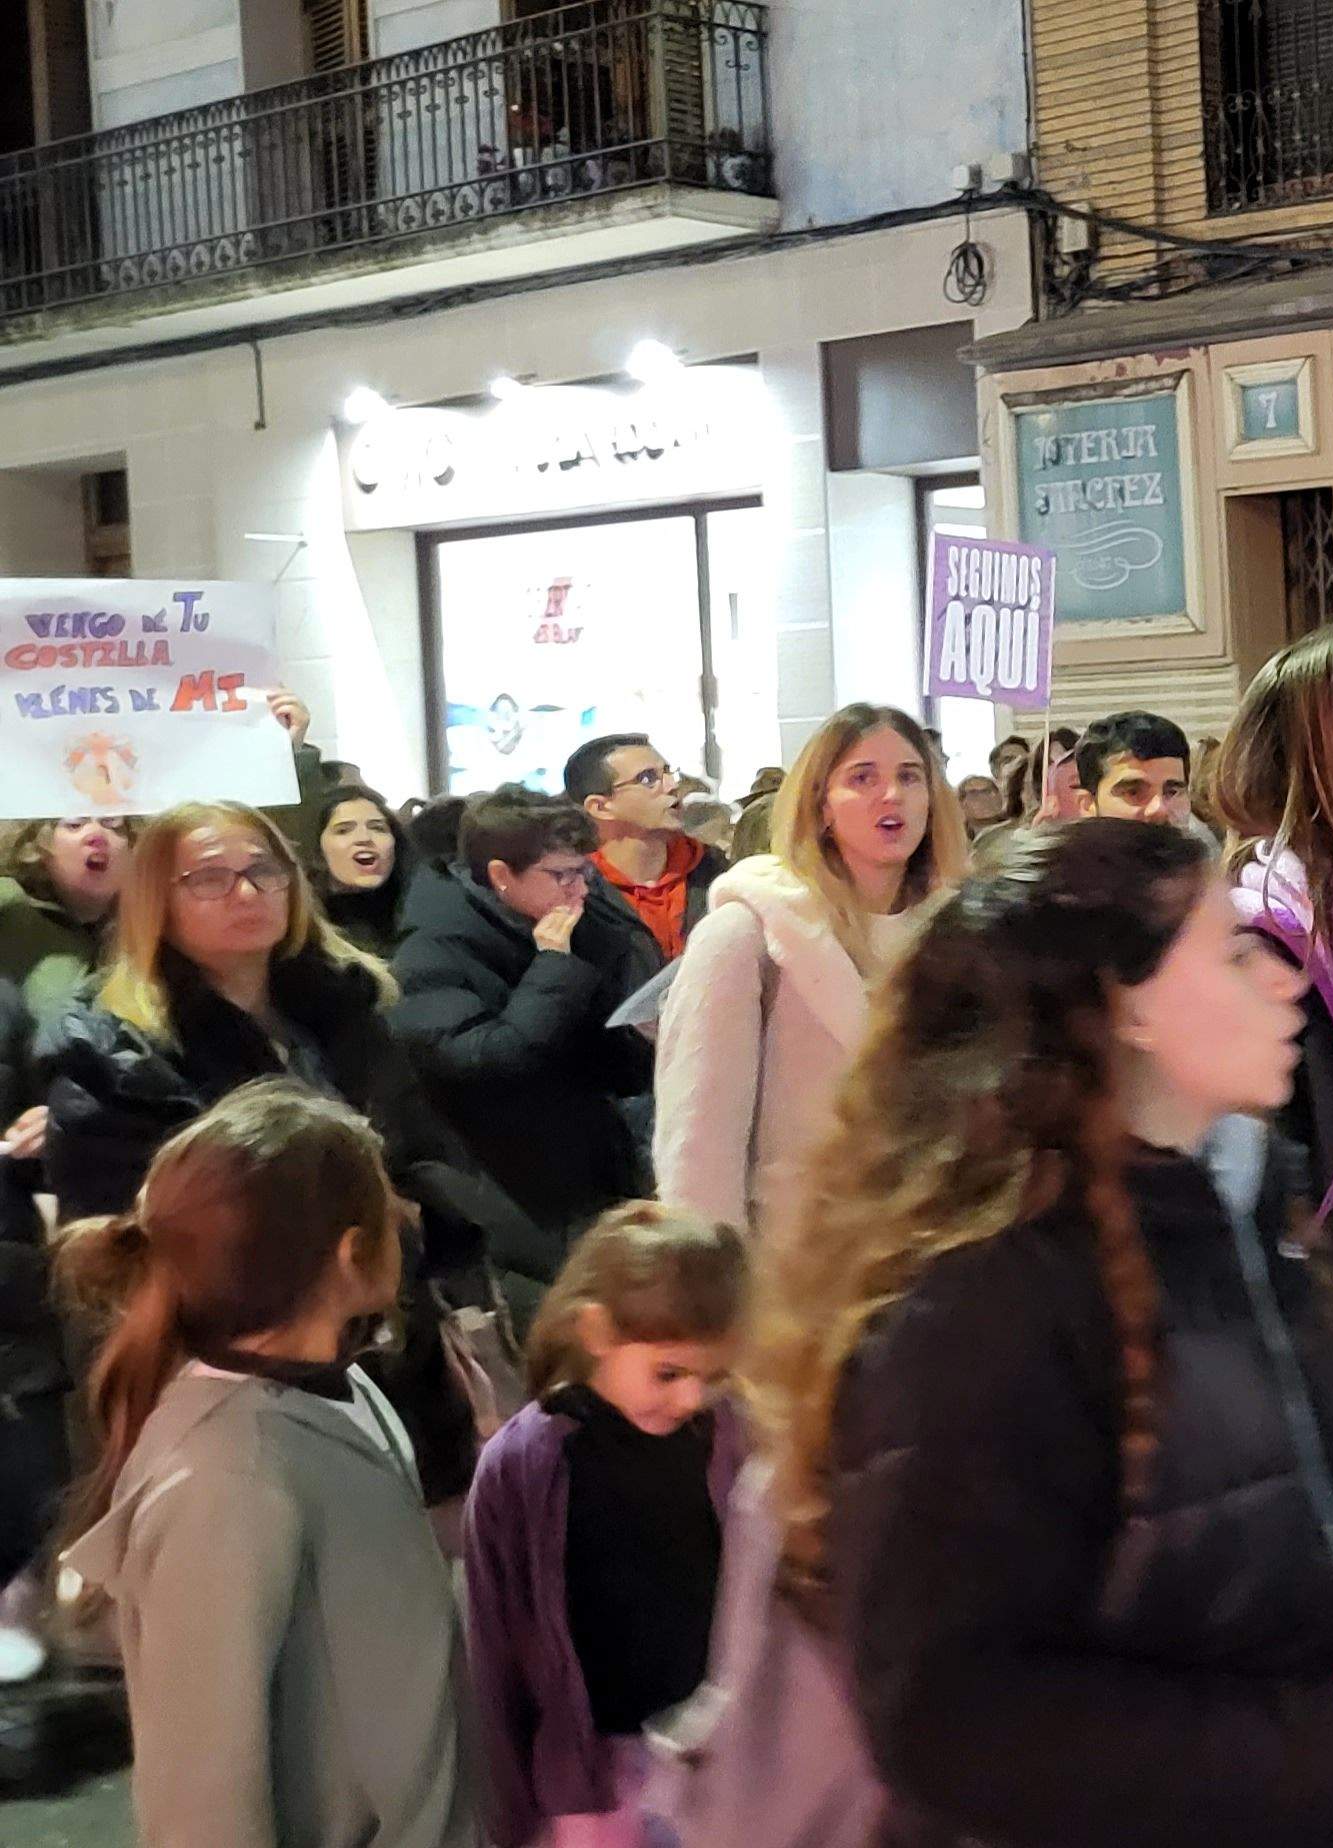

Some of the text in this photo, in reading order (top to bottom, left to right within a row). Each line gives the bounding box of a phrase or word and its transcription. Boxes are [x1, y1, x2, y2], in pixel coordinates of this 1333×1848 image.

[1257, 391, 1279, 429] 7
[947, 545, 1042, 607] SEGUIMOS
[25, 611, 126, 639] VENGO
[4, 640, 171, 671] COSTILLA
[939, 597, 1040, 696] AQUÍ
[129, 687, 160, 712] DE
[169, 670, 248, 713] MI
